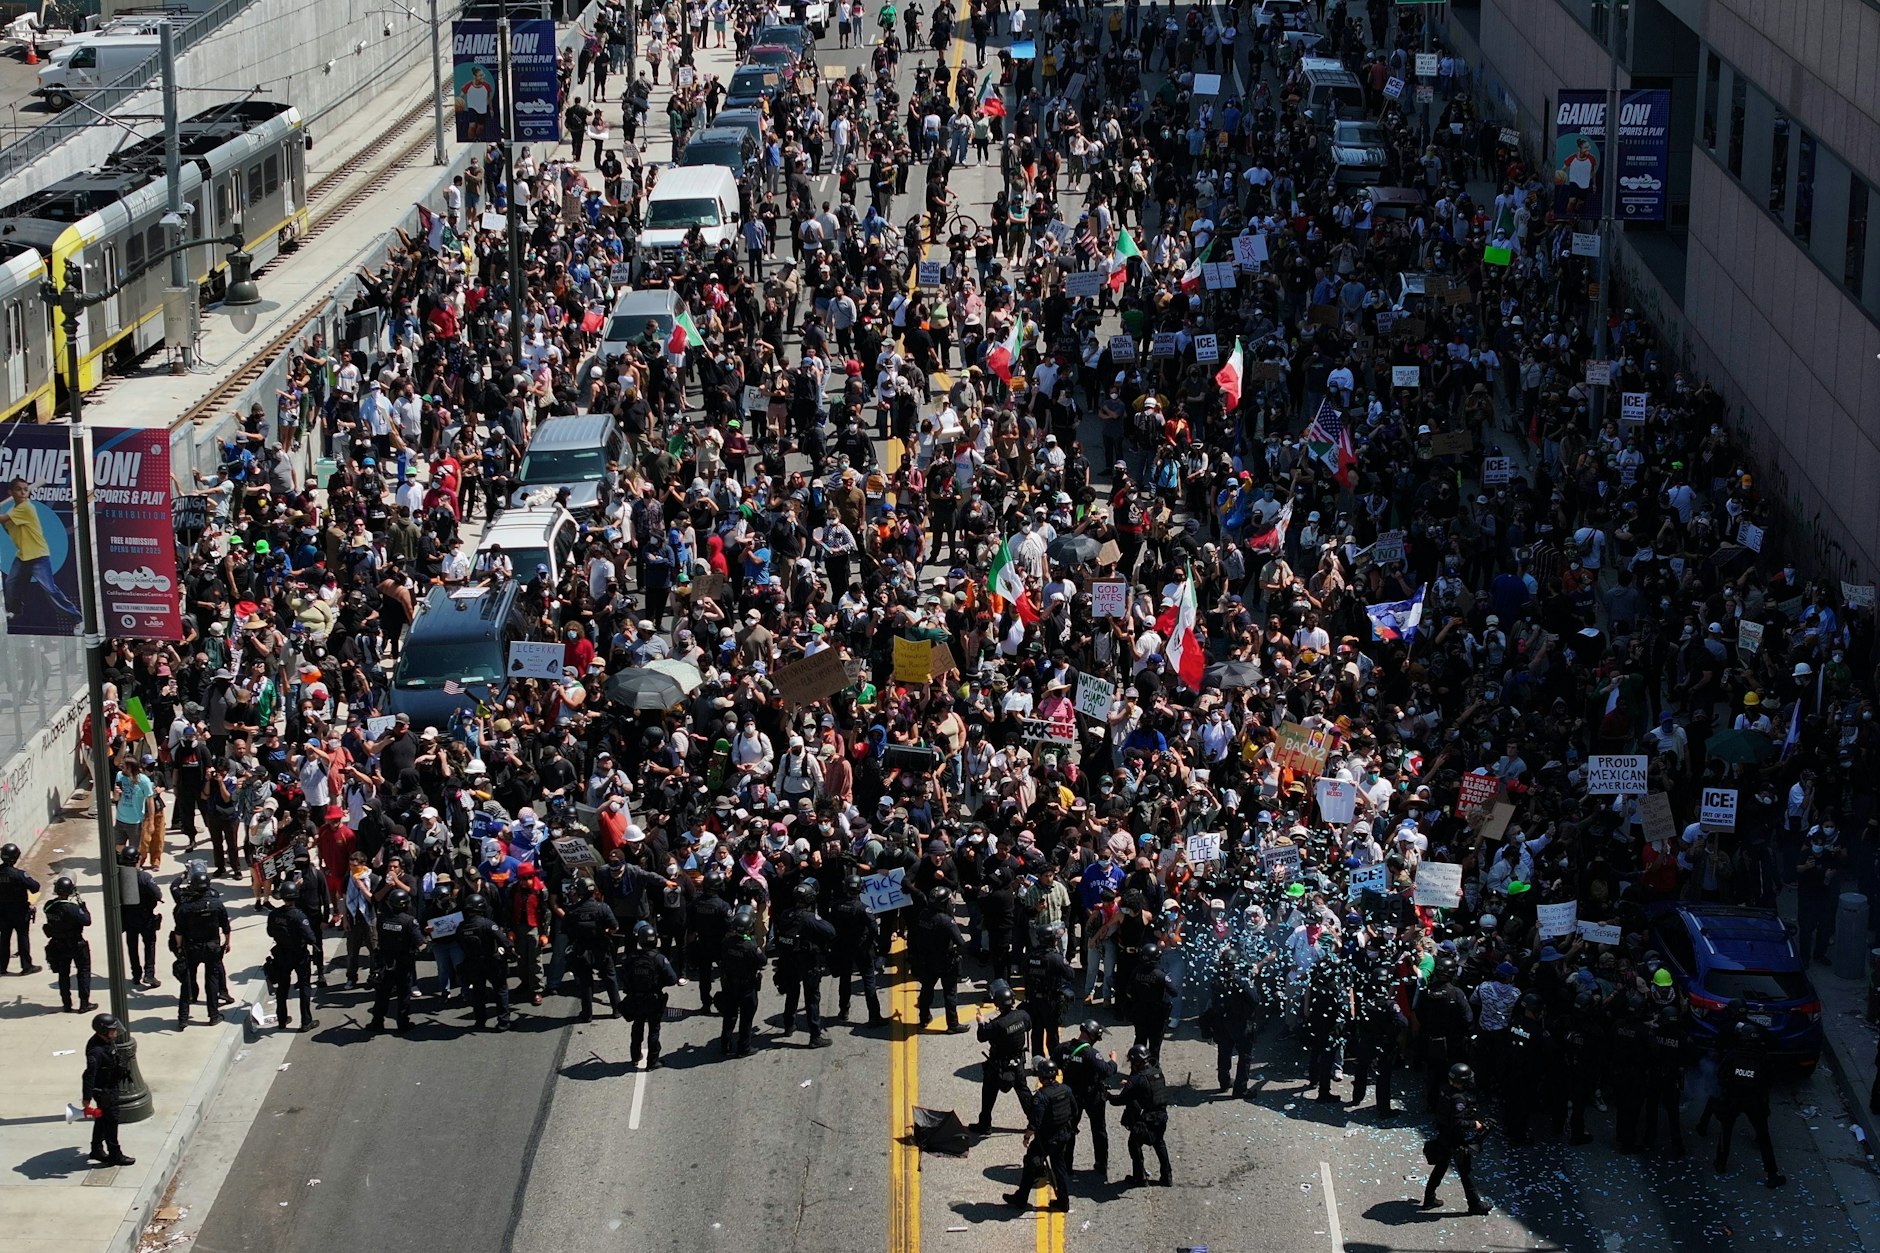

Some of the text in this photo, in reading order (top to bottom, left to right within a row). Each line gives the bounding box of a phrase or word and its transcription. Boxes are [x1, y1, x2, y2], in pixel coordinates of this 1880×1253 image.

[453, 33, 539, 54] GAME ON!
[510, 55, 532, 64] SPORTS
[538, 55, 553, 63] PLAY
[1557, 103, 1651, 125] GAME ON!
[1618, 127, 1642, 136] SPORTS
[1648, 127, 1665, 136] PLAY
[1197, 337, 1215, 349] ICE:
[1624, 396, 1644, 407] ICE:
[0, 447, 142, 487] GAME ON!
[1486, 460, 1507, 471] ICE:
[94, 489, 130, 505] SPORTS
[131, 491, 140, 505] &
[141, 491, 166, 506] PLAY
[171, 497, 206, 512] CHINGA
[105, 511, 166, 520] EXHIBITION
[110, 536, 158, 546] FREE ADMISSION
[110, 545, 161, 555] OPENS MAY 2025
[1378, 549, 1398, 559] NO
[1097, 585, 1119, 594] GOD
[1094, 594, 1123, 602] HATES
[1100, 603, 1116, 612] ICE
[516, 644, 536, 653] ICE
[901, 643, 924, 652] STOP
[1078, 674, 1112, 697] NATIONAL
[1082, 689, 1106, 708] GUARD
[1082, 702, 1097, 716] LOL
[1051, 724, 1074, 739] ICE
[1285, 737, 1326, 761] BACK 2
[1598, 757, 1637, 768] PROUD
[1589, 770, 1646, 781] MEXICAN
[1463, 781, 1497, 793] ILLEGAL
[1590, 781, 1646, 791] AMERICAN
[1704, 792, 1734, 808] ICE:
[560, 841, 581, 849] FULL
[1189, 836, 1218, 850] FUCK
[558, 847, 589, 855] RIGHTS
[1189, 847, 1213, 862] ICE
[1352, 869, 1383, 884] ICE:
[864, 874, 900, 893] FUCK
[870, 890, 904, 909] ICE
[1734, 1068, 1756, 1078] POLICE
